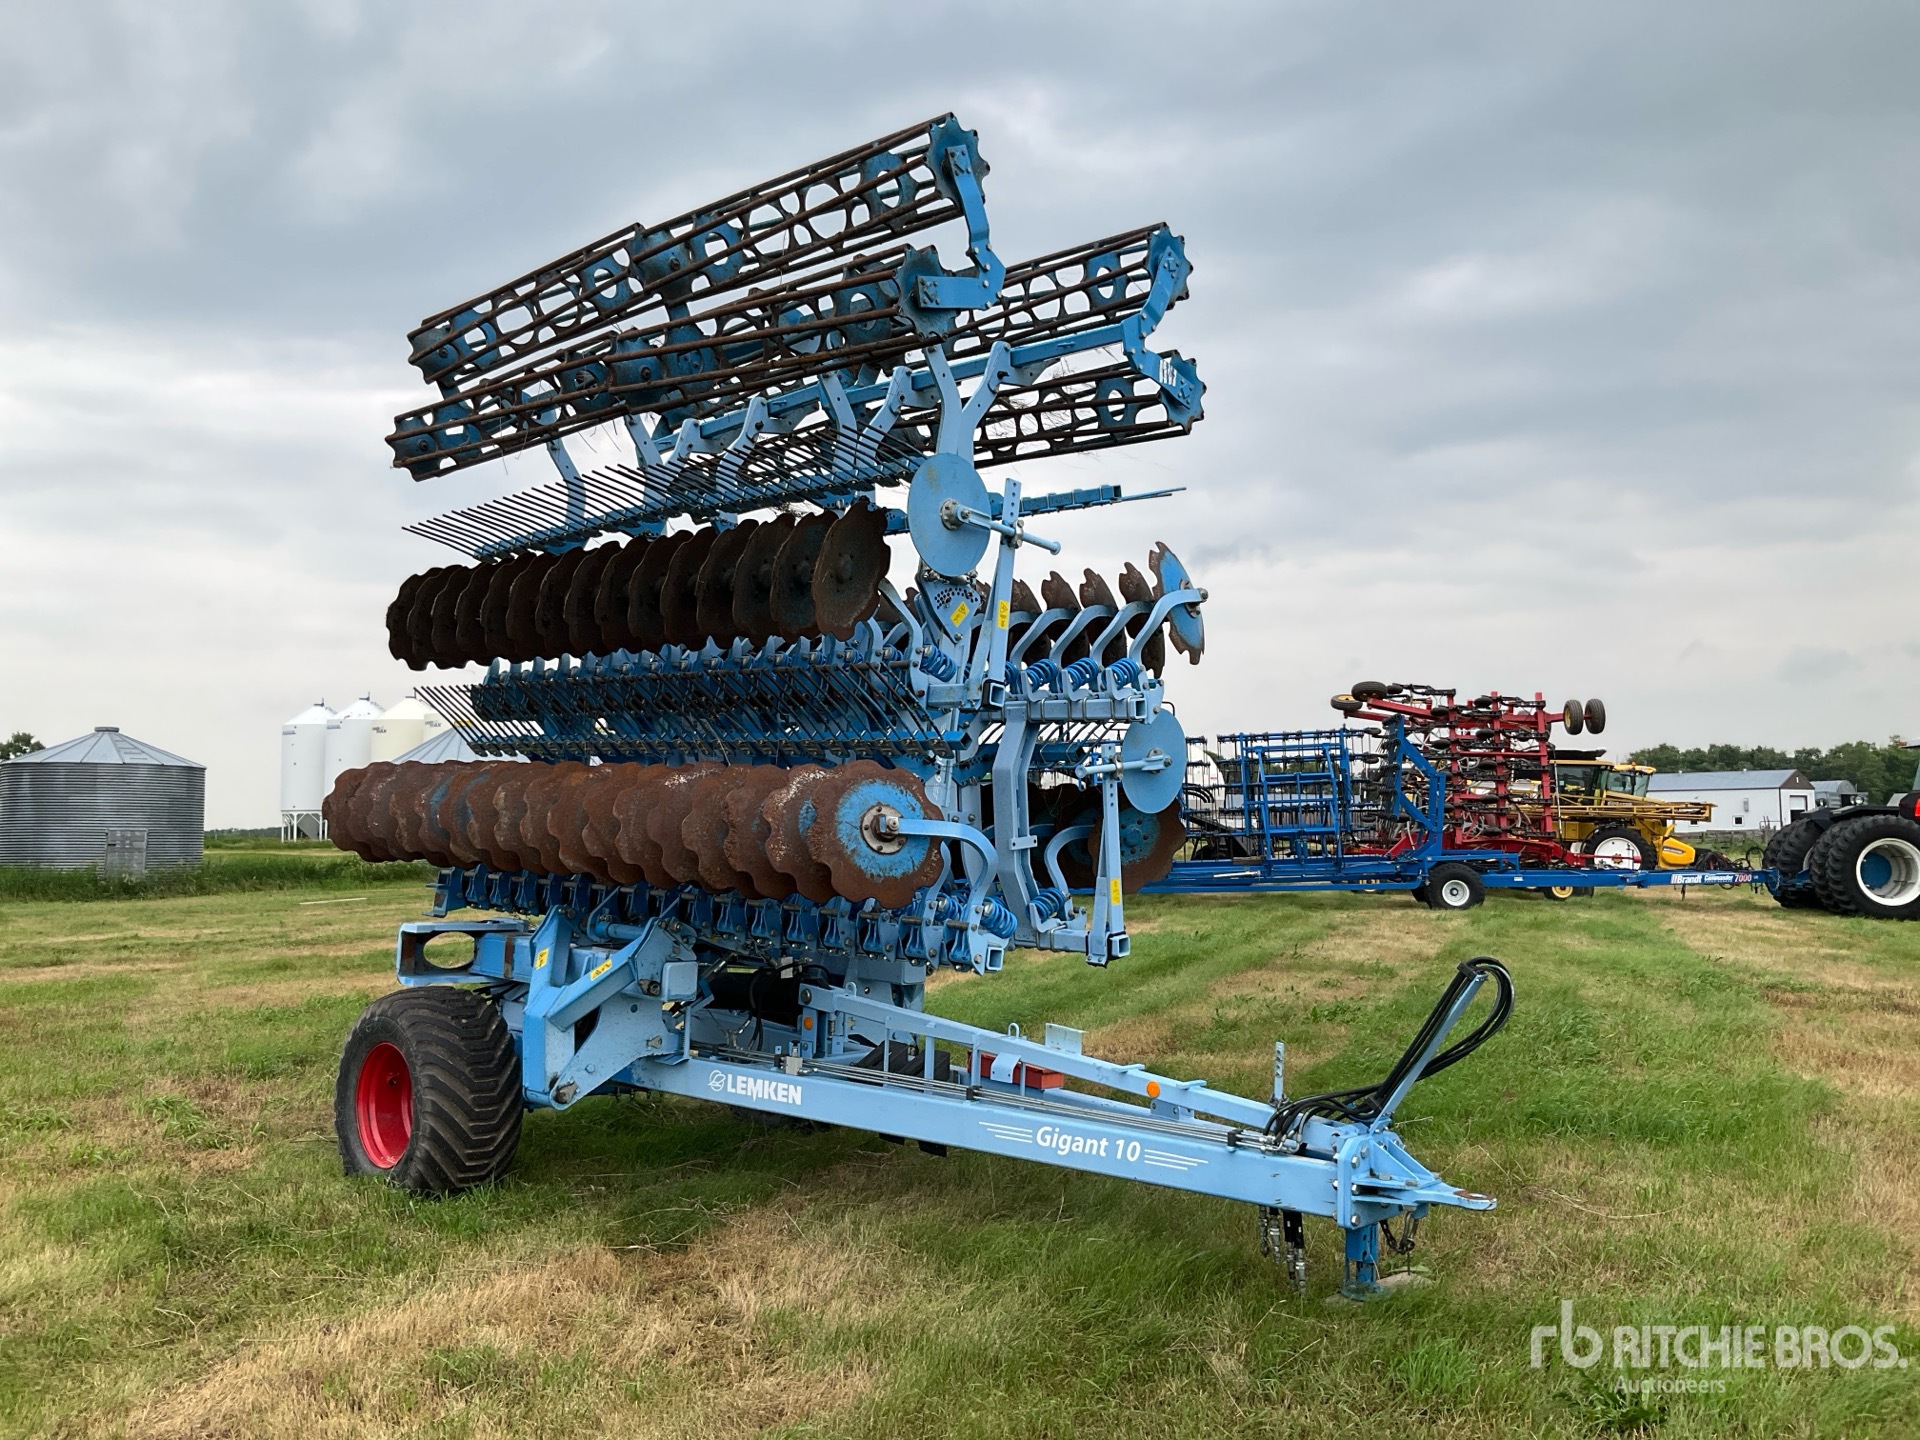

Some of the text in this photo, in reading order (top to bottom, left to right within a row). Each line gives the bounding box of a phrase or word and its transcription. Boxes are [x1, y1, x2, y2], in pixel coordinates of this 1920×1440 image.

[1677, 874, 1702, 883] Brandt
[1735, 874, 1752, 882] 7000
[727, 1074, 802, 1105] LEMKEN
[1036, 1126, 1141, 1162] Gigant 10
